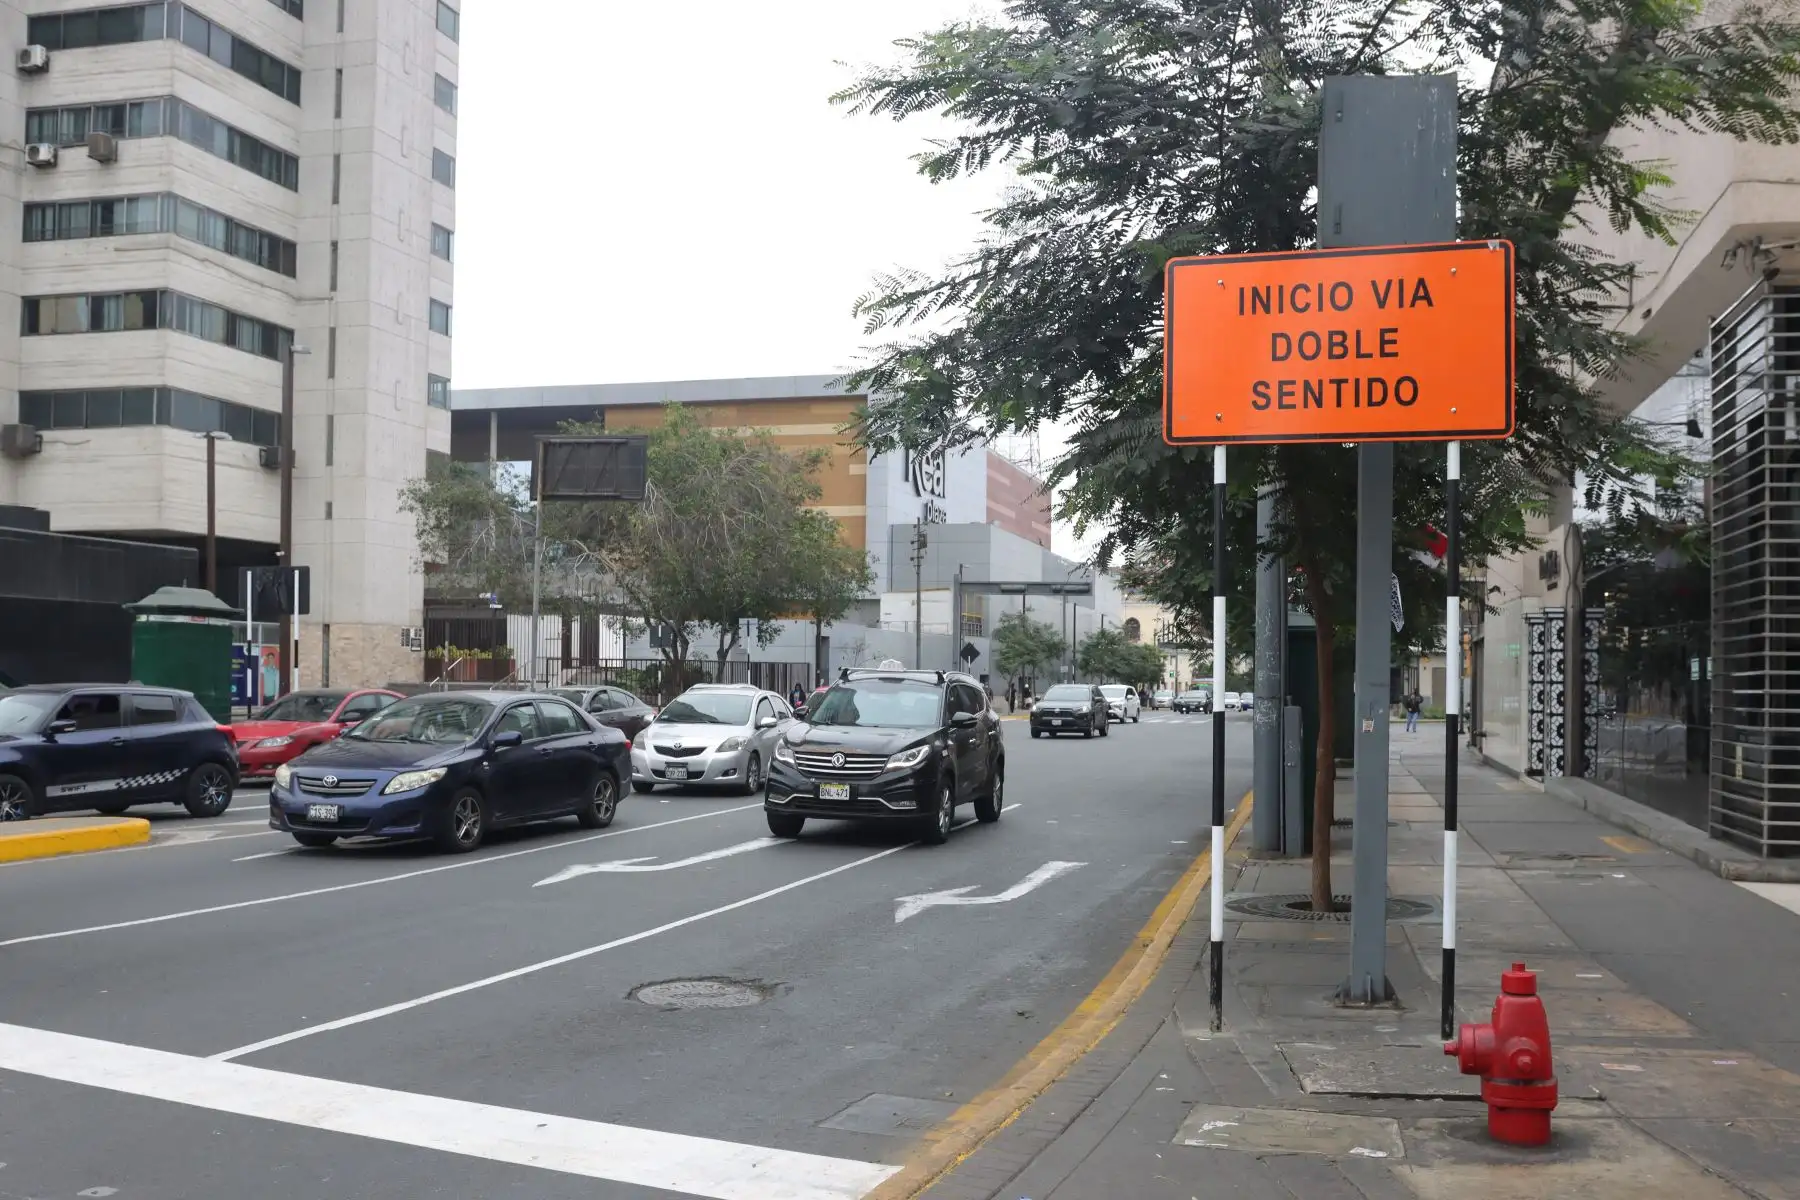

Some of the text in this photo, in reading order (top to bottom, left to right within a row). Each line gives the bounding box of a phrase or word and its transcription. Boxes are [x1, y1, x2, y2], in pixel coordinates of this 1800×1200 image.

[1238, 277, 1434, 316] INICIO VIA
[1271, 328, 1399, 362] DOBLE
[1251, 376, 1419, 411] SENTIDO
[820, 788, 848, 797] BNL-471
